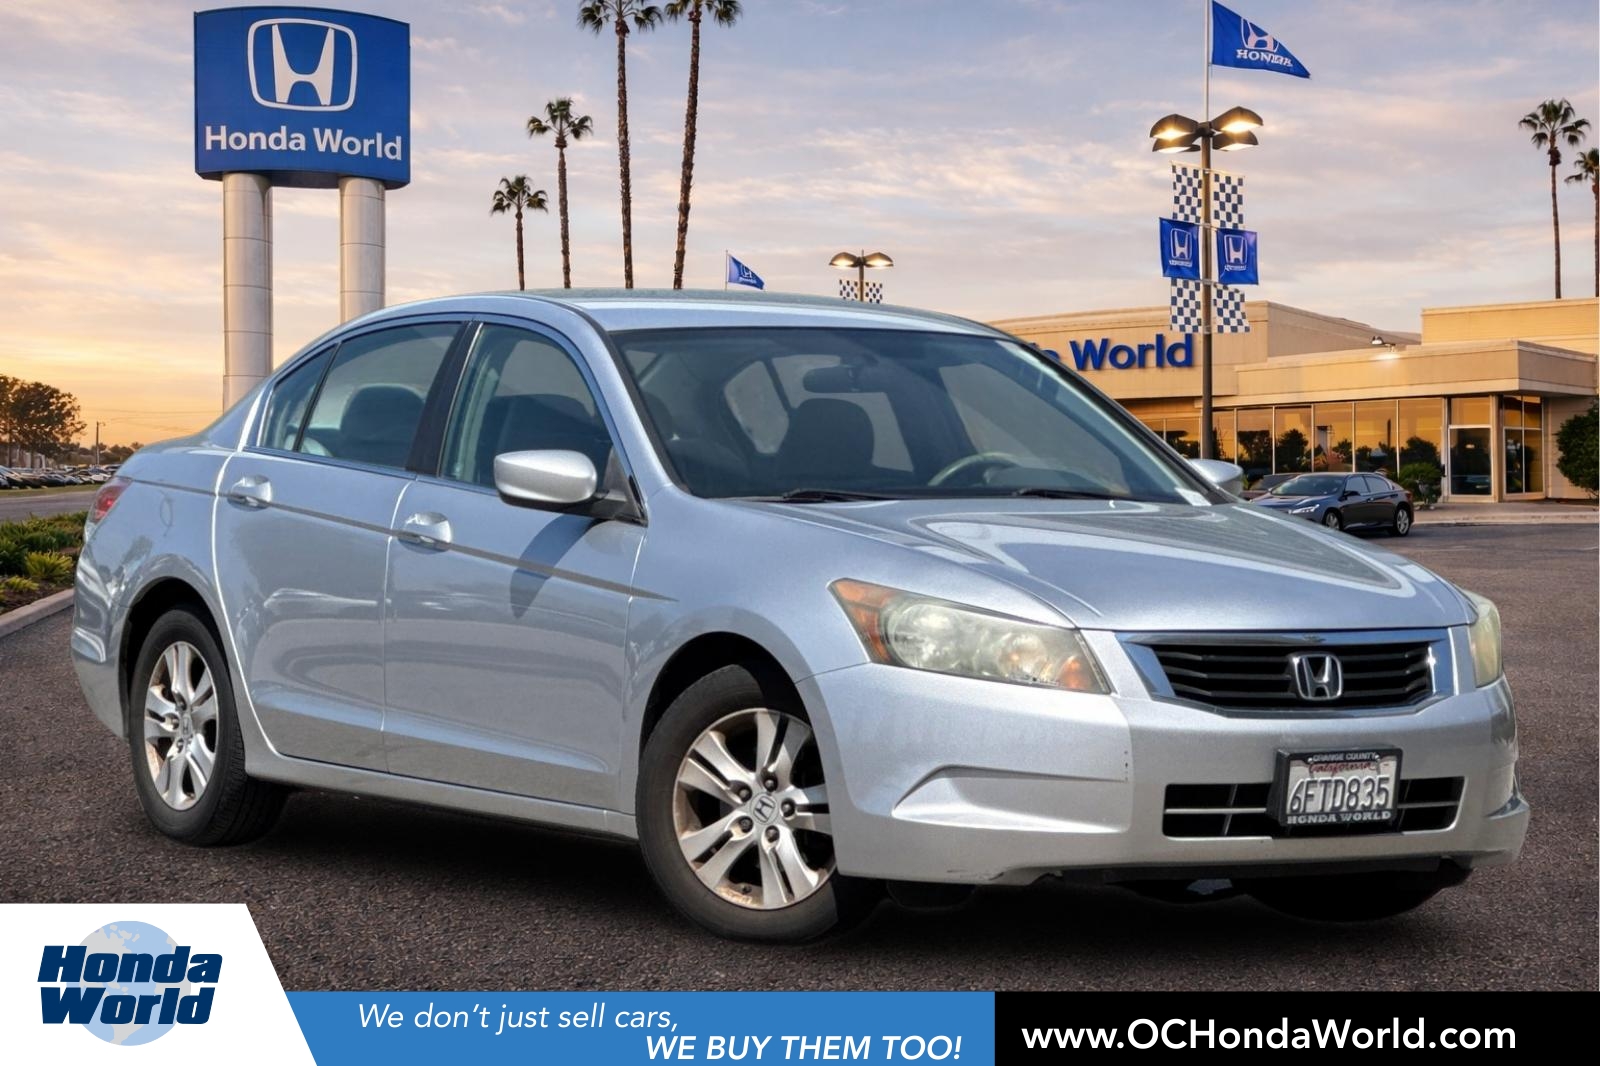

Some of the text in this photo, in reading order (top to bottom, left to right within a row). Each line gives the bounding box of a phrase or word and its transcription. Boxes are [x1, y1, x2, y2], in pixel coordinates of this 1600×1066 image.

[205, 125, 403, 161] Honda World
[1069, 333, 1194, 371] World
[1310, 761, 1377, 776] California
[1345, 751, 1377, 761] COUNTY
[1289, 775, 1390, 813] 6FTD835
[1287, 811, 1392, 825] HONDA WORLD
